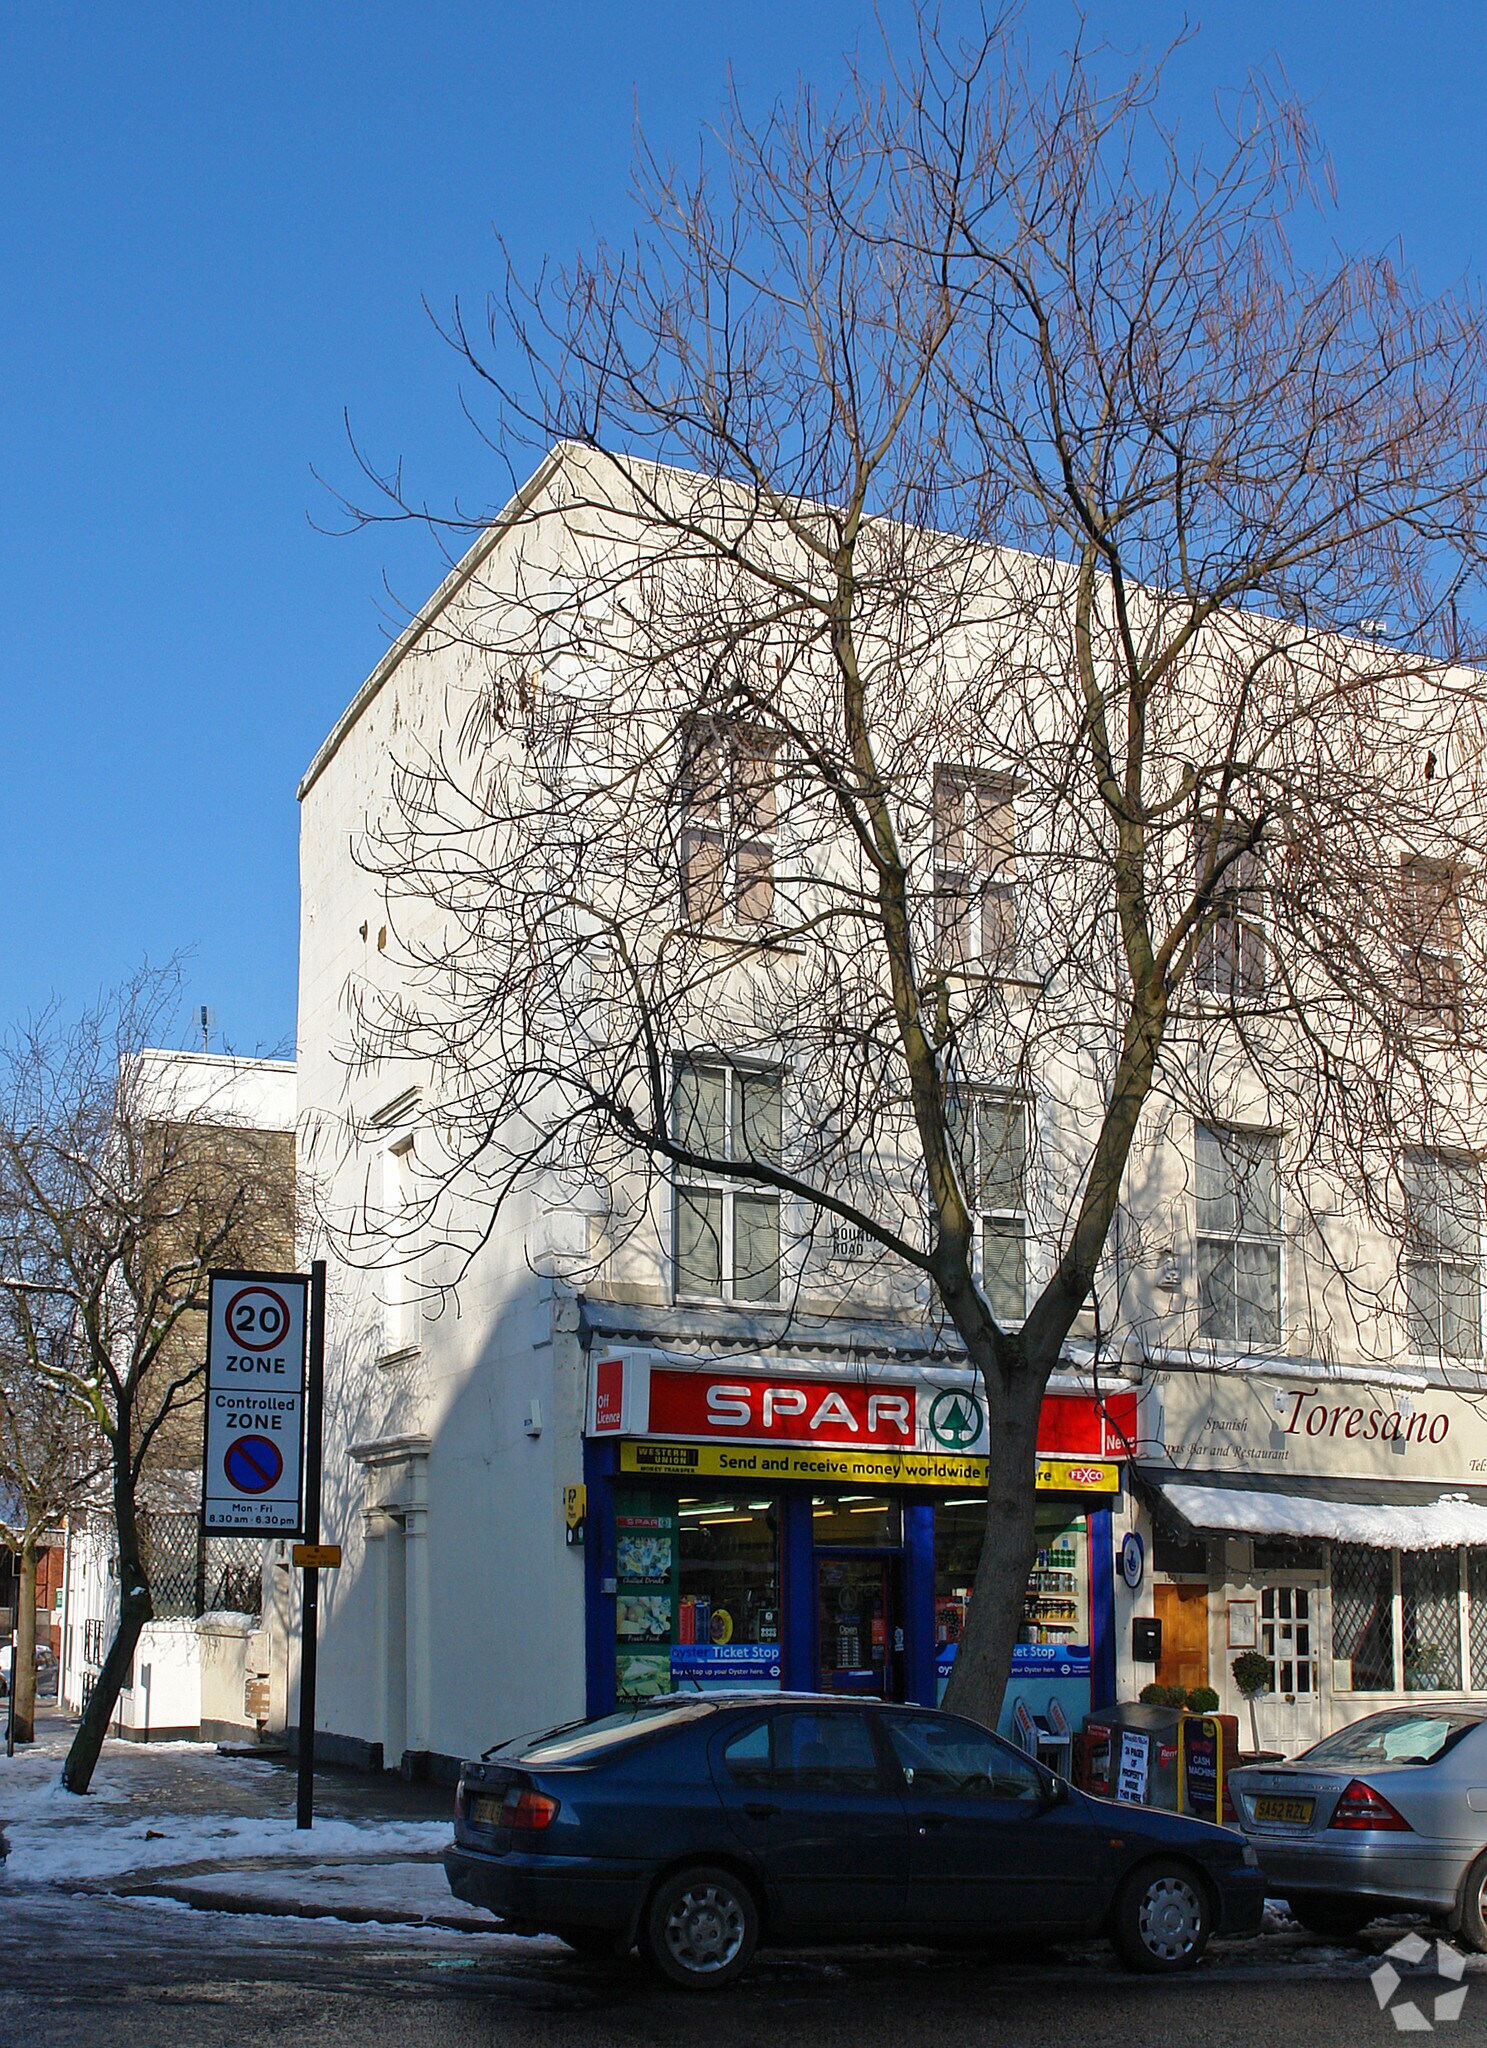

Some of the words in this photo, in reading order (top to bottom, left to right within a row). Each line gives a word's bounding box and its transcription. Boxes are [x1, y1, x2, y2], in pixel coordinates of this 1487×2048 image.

[834, 1242, 863, 1256] ROAD
[236, 1305, 280, 1333] 20
[226, 1355, 286, 1374] ZONE
[215, 1395, 295, 1412] Controlled
[597, 1395, 610, 1409] Off
[706, 1385, 910, 1434] SPAR
[226, 1412, 283, 1430] ZONE
[597, 1409, 621, 1425] Licence
[1283, 1388, 1449, 1444] Toresano
[1204, 1417, 1248, 1433] Spanish
[638, 1447, 687, 1457] WESTERN
[655, 1456, 687, 1464] UNION
[1187, 1443, 1206, 1456] Bar
[1210, 1444, 1229, 1457] and
[1233, 1446, 1289, 1461] Restaurant
[719, 1454, 757, 1469] Send
[761, 1457, 789, 1471] and
[793, 1458, 847, 1474] receive
[853, 1463, 900, 1479] money
[905, 1462, 981, 1478] worldwide
[1071, 1468, 1103, 1484] FEXCO
[232, 1503, 253, 1512] Mon
[260, 1504, 273, 1513] Fri
[209, 1514, 232, 1523] 8.30
[255, 1515, 278, 1524] 6.30
[280, 1518, 295, 1526] pm
[713, 1646, 750, 1659] Ticket
[752, 1646, 779, 1660] Stop
[1031, 1646, 1055, 1659] Stop
[1193, 1755, 1211, 1766] CASH
[1188, 1765, 1217, 1778] MACHINE
